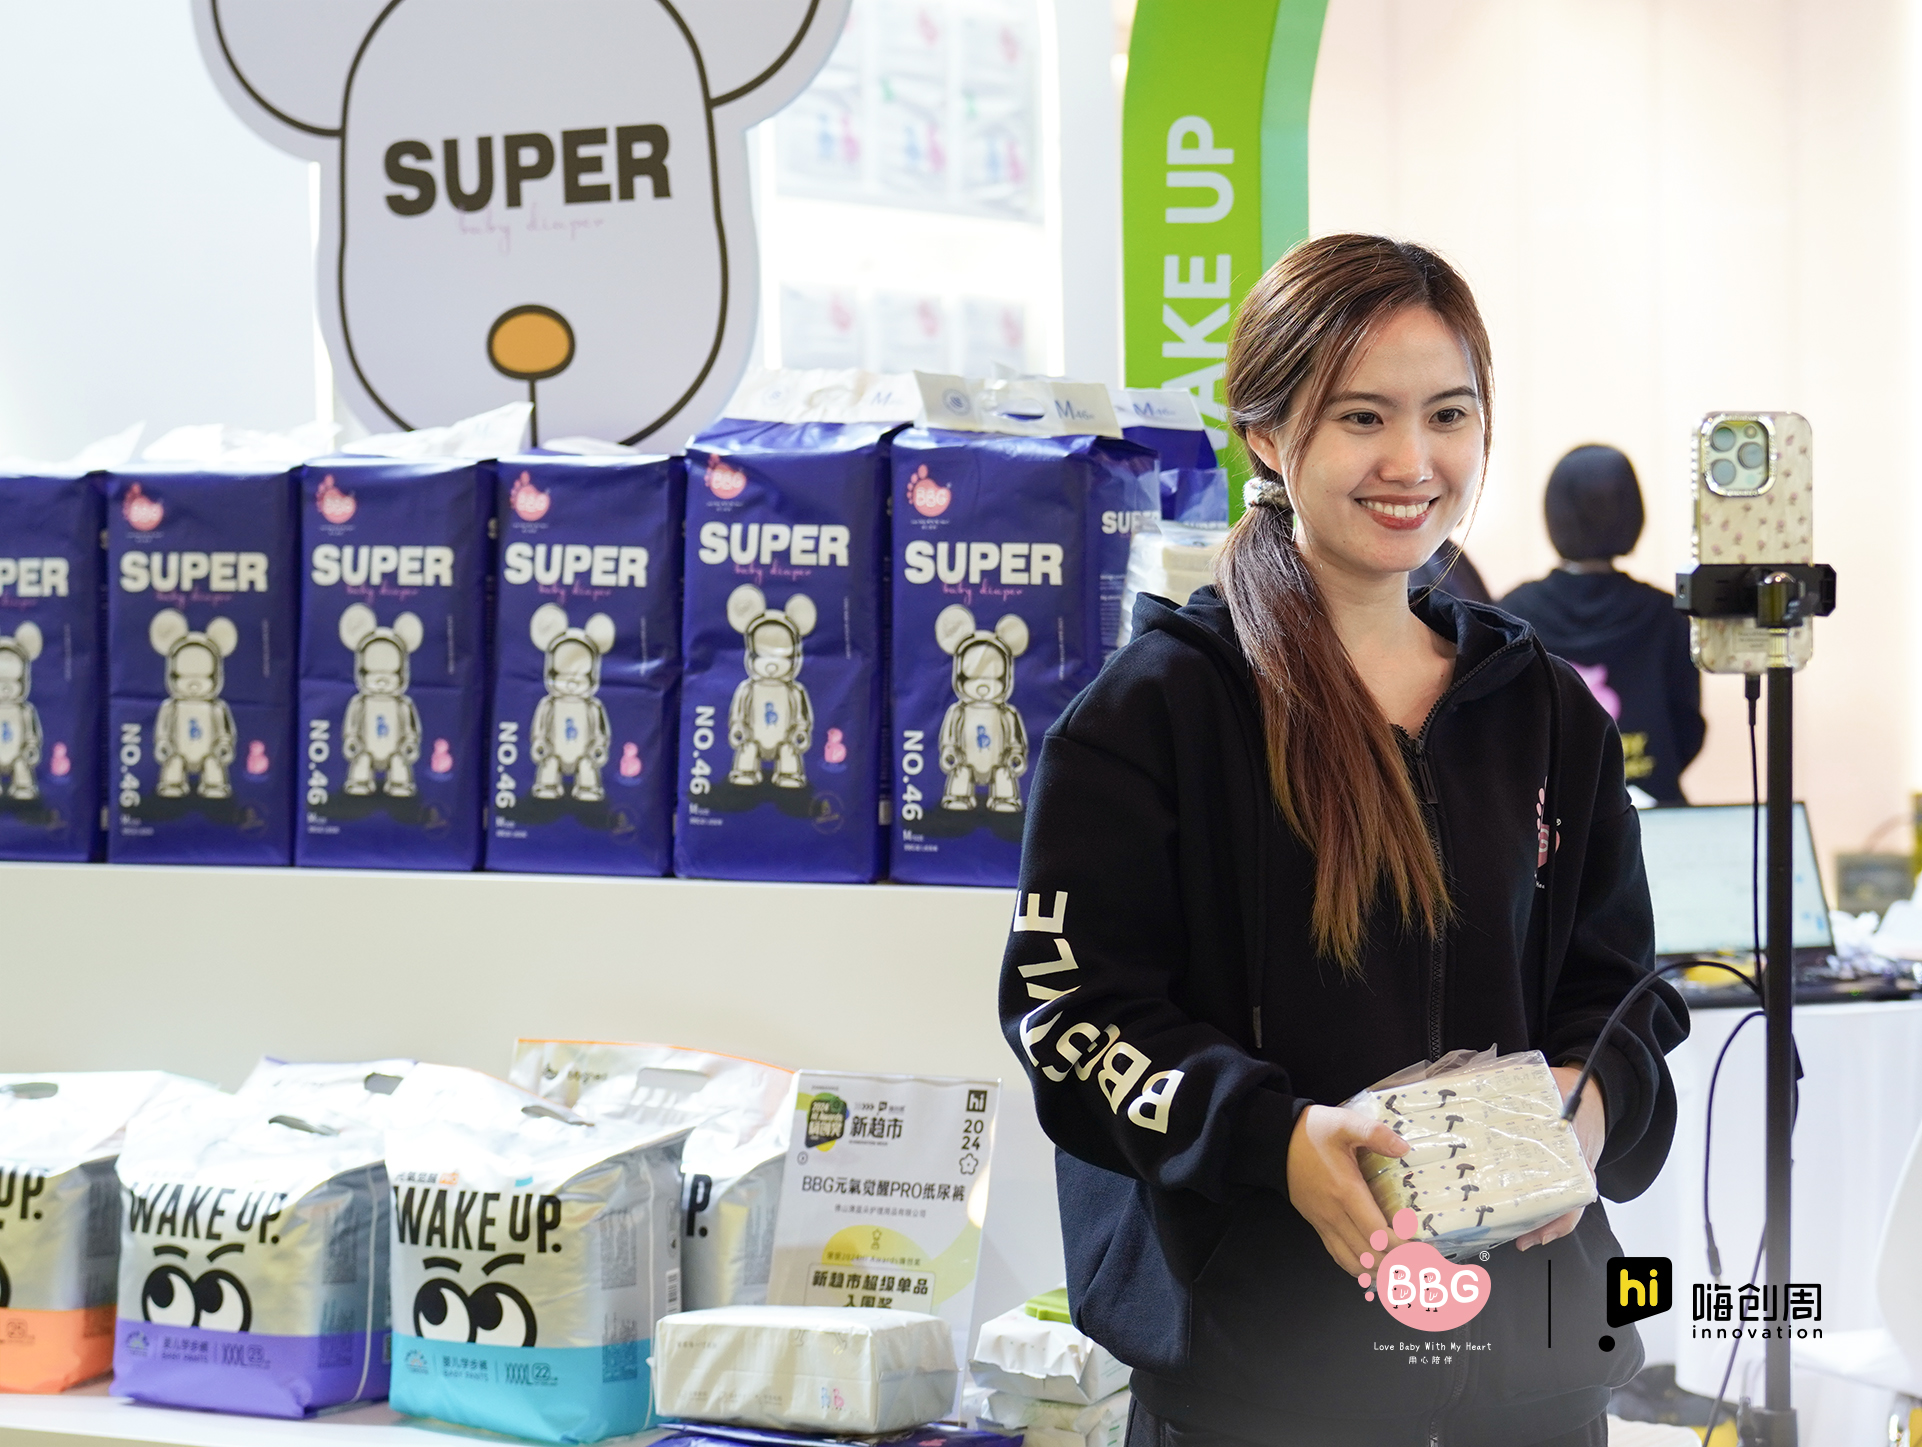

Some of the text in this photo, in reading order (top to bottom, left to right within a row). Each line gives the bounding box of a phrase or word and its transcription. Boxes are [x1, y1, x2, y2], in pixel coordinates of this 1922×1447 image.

[383, 123, 672, 217] SUPER
[1165, 115, 1234, 223] UP
[119, 550, 268, 592] SUPER
[311, 544, 455, 586] SUPER
[503, 542, 649, 588] SUPER
[698, 521, 850, 566] SUPER
[904, 540, 1064, 585] SUPER
[119, 723, 142, 808] NO.46
[307, 719, 331, 806] NO.46
[495, 721, 519, 809] NO.46
[689, 705, 715, 795] NO.46
[902, 730, 924, 821] NO.46
[961, 1135, 981, 1150] 24
[963, 1119, 984, 1134] 20
[130, 1181, 288, 1243] WAKE UP.
[393, 1186, 501, 1252] WAKE
[509, 1193, 562, 1254] UP.
